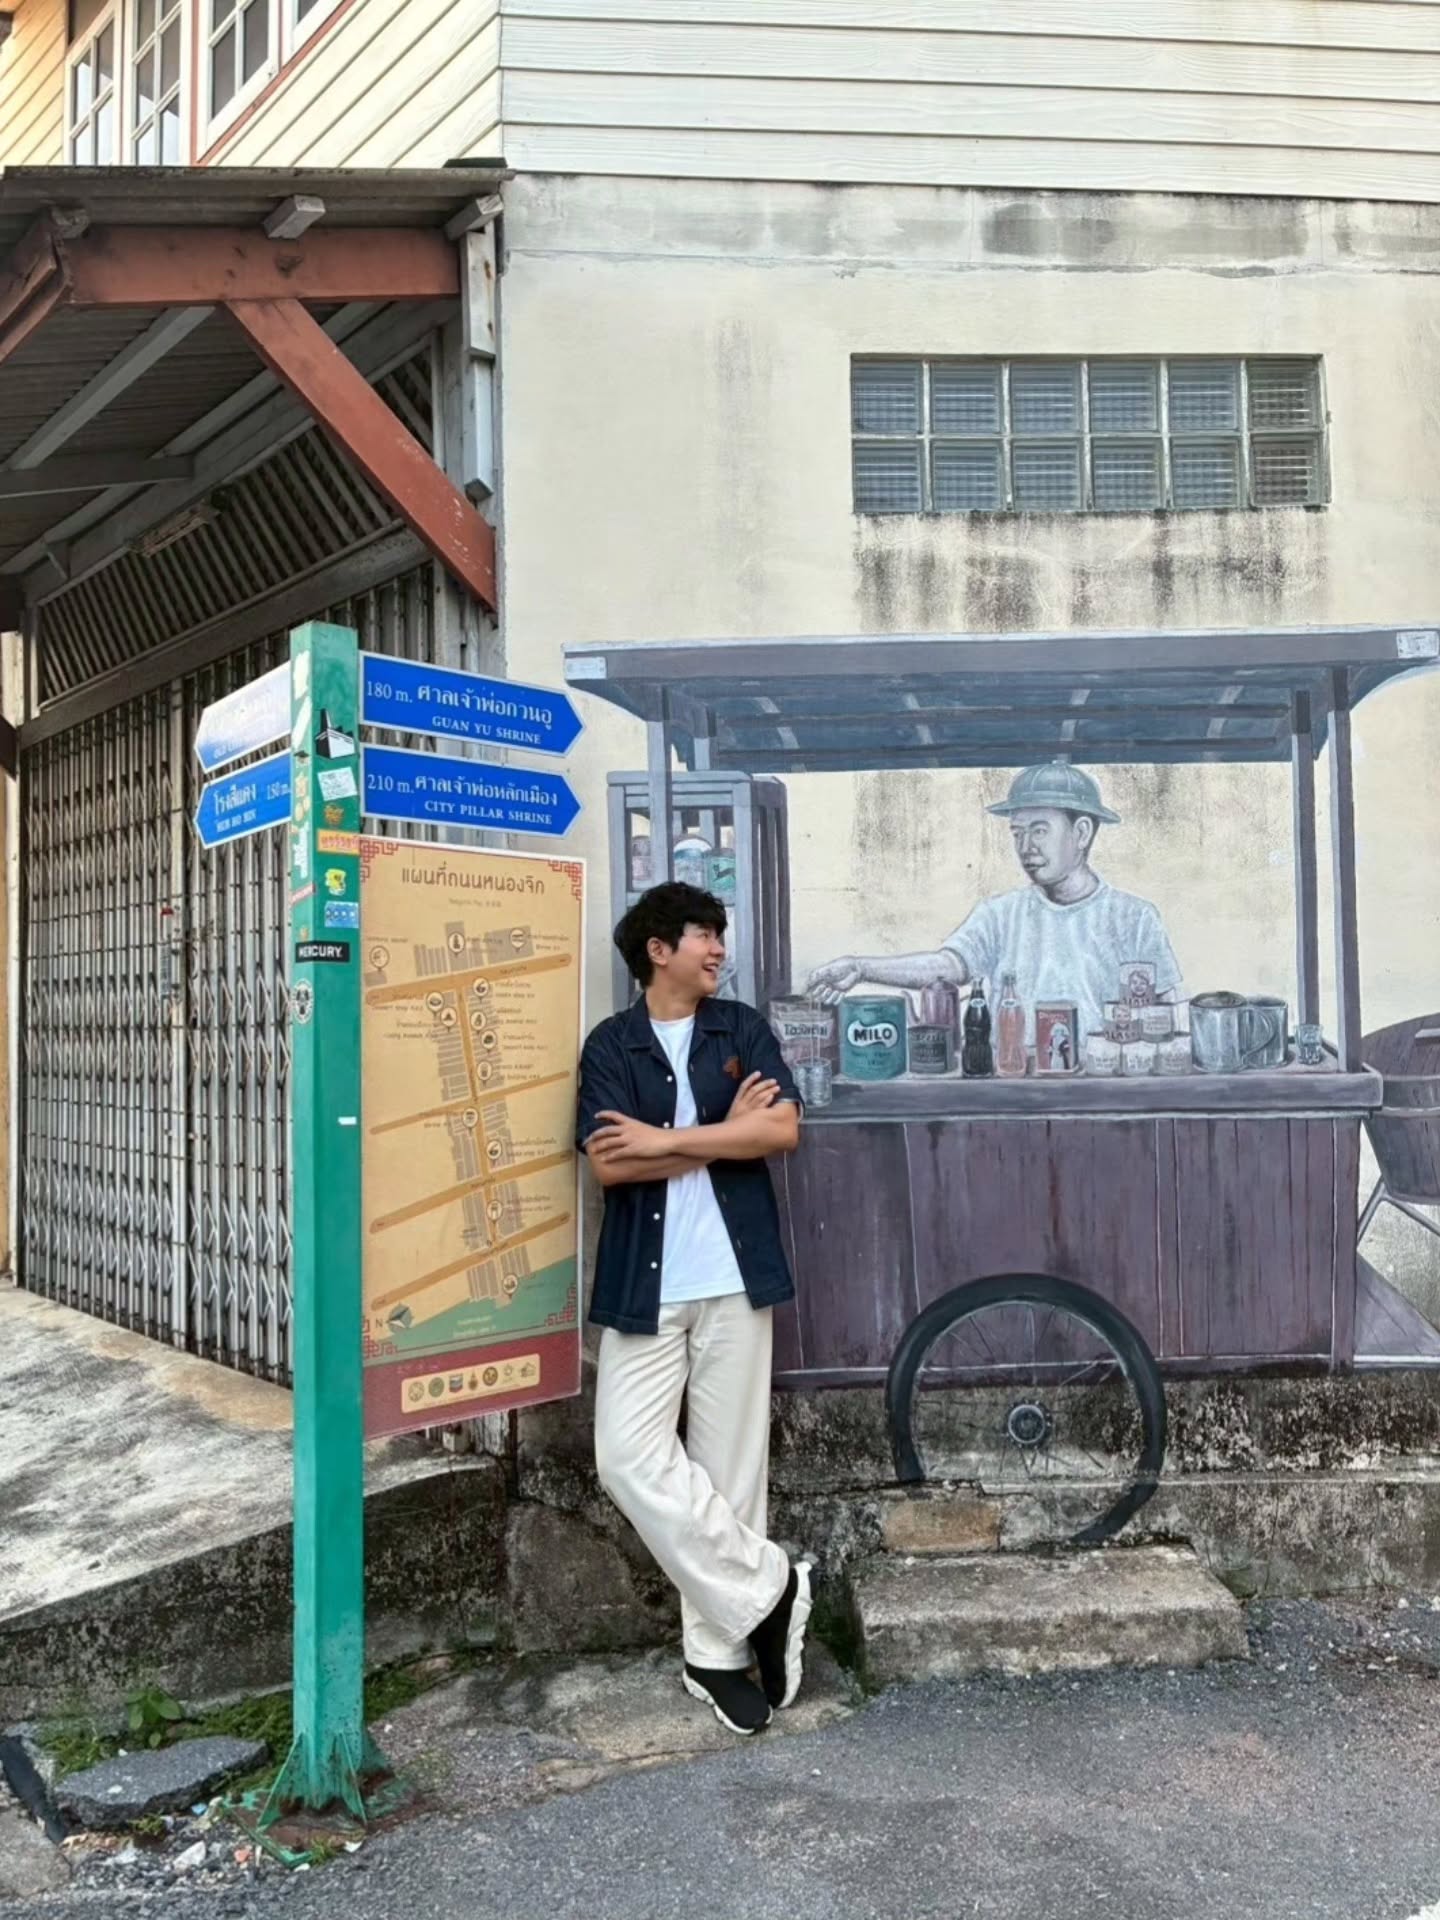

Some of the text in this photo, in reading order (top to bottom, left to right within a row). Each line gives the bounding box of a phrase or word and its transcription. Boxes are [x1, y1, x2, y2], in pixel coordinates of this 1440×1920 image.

[366, 681, 553, 731] 180 m. ศาลเจ้าพ่อกวนอู
[431, 715, 542, 745] GUAN YU SHRINE
[367, 774, 394, 792] 210
[397, 780, 415, 794] m.
[415, 775, 558, 807] ศาลเจ้าพ่อหลักเมือง
[424, 800, 553, 825] CITY PILLAR SHRINE
[402, 860, 545, 895] แผนที่ถนนหนองจิก
[298, 945, 343, 959] MERCURY
[854, 1028, 893, 1042] MILO
